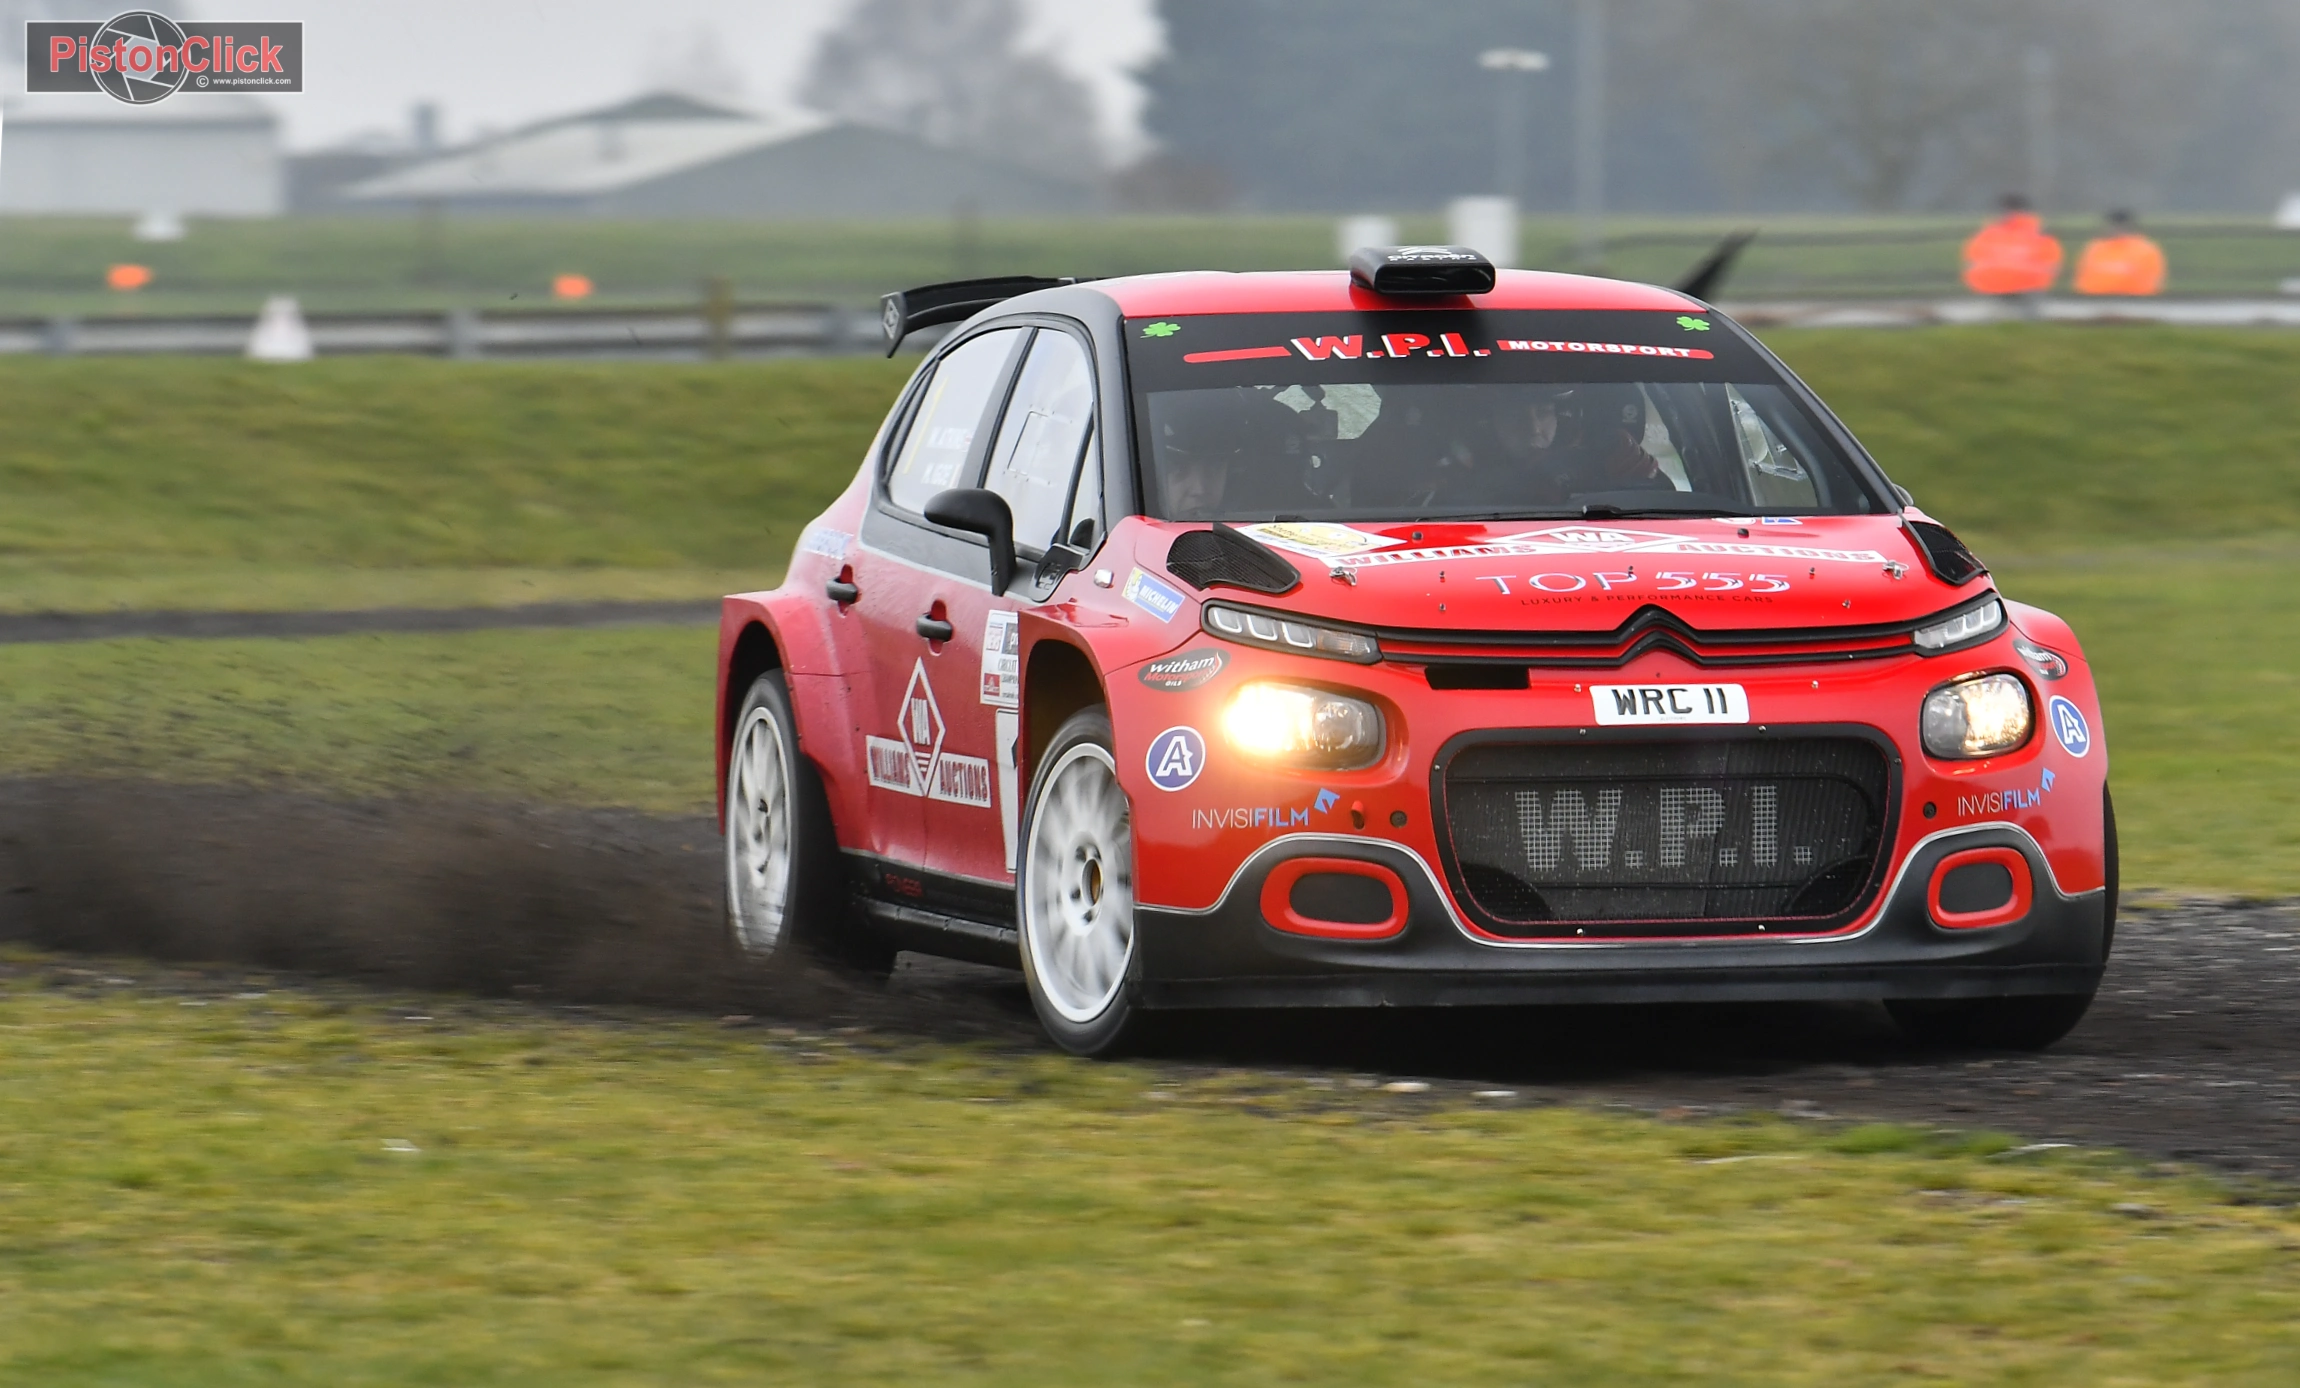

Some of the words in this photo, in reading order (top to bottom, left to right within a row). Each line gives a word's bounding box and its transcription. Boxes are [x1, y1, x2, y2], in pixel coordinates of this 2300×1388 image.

[1290, 332, 1492, 361] W.P.I.
[1508, 340, 1691, 357] MOTORSPORT
[1337, 544, 1537, 565] WILLIAMS
[1676, 543, 1876, 561] AUCTIONS
[1475, 571, 1638, 595] TOP
[1655, 571, 1791, 593] 555
[1140, 584, 1180, 615] MICHELIN
[1521, 595, 1582, 606] LUXURY
[1606, 594, 1725, 602] PERFORMANCE
[1732, 595, 1774, 603] CARS
[1149, 656, 1215, 673] witham
[1611, 687, 1693, 716] WRC
[870, 745, 912, 789] WILLIAMS
[939, 759, 988, 802] AUCTIONS
[1957, 787, 2042, 817] INVISIFILM
[1191, 806, 1310, 829] INVISIFILM
[1514, 785, 1813, 871] W.P.I.
